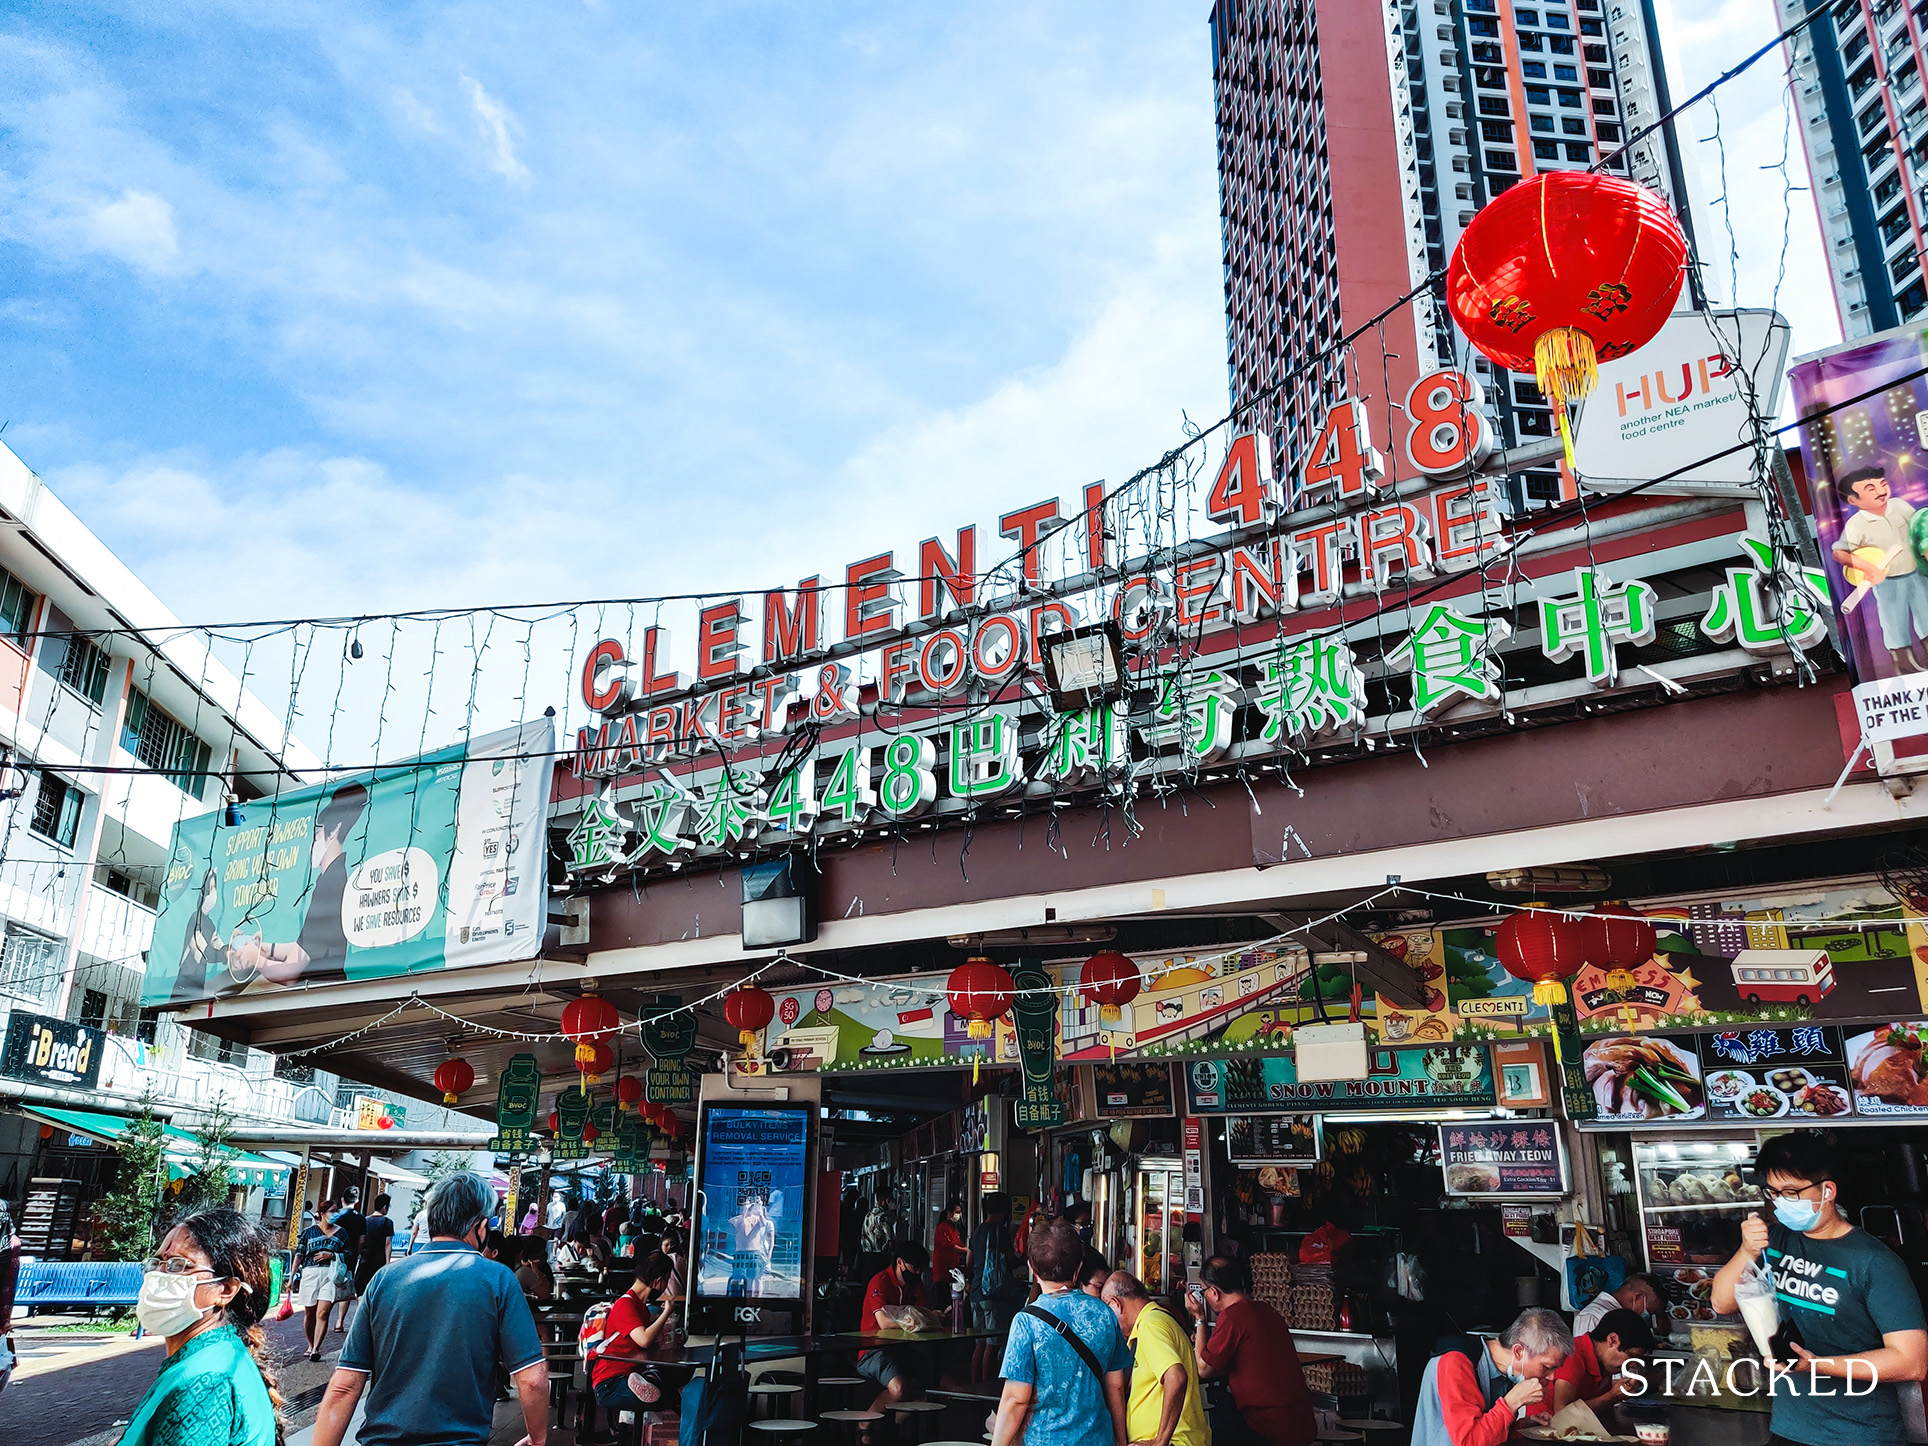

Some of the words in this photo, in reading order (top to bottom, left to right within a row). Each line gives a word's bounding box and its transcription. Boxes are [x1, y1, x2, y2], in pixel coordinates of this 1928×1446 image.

[1615, 353, 1732, 417] HUP
[1620, 412, 1663, 431] another
[1665, 405, 1691, 418] NEA
[1693, 391, 1737, 411] market/
[1621, 427, 1647, 441] food
[1650, 418, 1685, 433] centre
[580, 479, 1112, 713] CLEMENTI
[1207, 368, 1488, 530] 448
[572, 674, 796, 778] MARKET
[810, 662, 854, 721] &
[880, 600, 1080, 702] FOOD
[1111, 480, 1497, 645] CENTRE
[1862, 690, 1913, 711] THANK
[1866, 712, 1885, 729] OF
[1889, 706, 1921, 724] THE
[226, 827, 266, 857] SUPPORT
[484, 845, 497, 854] YES
[223, 857, 250, 883] BRING
[276, 845, 300, 871] OWN
[370, 868, 383, 884] YOU
[384, 864, 401, 881] SAVE
[404, 860, 410, 877] $
[359, 889, 390, 908] HAWKERS
[412, 882, 419, 899] $
[353, 916, 364, 932] WE
[366, 913, 382, 929] SAVE
[383, 906, 421, 927] RESOURCES
[1645, 990, 1664, 1000] NOW
[784, 1002, 794, 1011] SG
[784, 1011, 794, 1019] 50
[660, 1031, 680, 1039] BYOC
[26, 1023, 92, 1073] iBread
[1027, 1040, 1046, 1051] BYOC
[659, 1059, 681, 1071] BRING
[650, 1072, 670, 1085] YOUR
[672, 1072, 690, 1085] OWN
[650, 1086, 690, 1099] CONTAINER
[1270, 1082, 1335, 1099] SNOW
[1345, 1079, 1428, 1097] MOUNT
[1019, 1104, 1061, 1121] 自备瓶子
[726, 1121, 758, 1129] BULKY
[760, 1121, 789, 1129] ITEMS
[490, 1139, 535, 1150] 自备盒子
[713, 1132, 757, 1140] REMOVAL
[760, 1132, 801, 1141] SERVICE
[1520, 1149, 1552, 1161] TEOW
[1647, 1227, 1679, 1236] SINGAPORE
[1779, 1254, 1823, 1278] new
